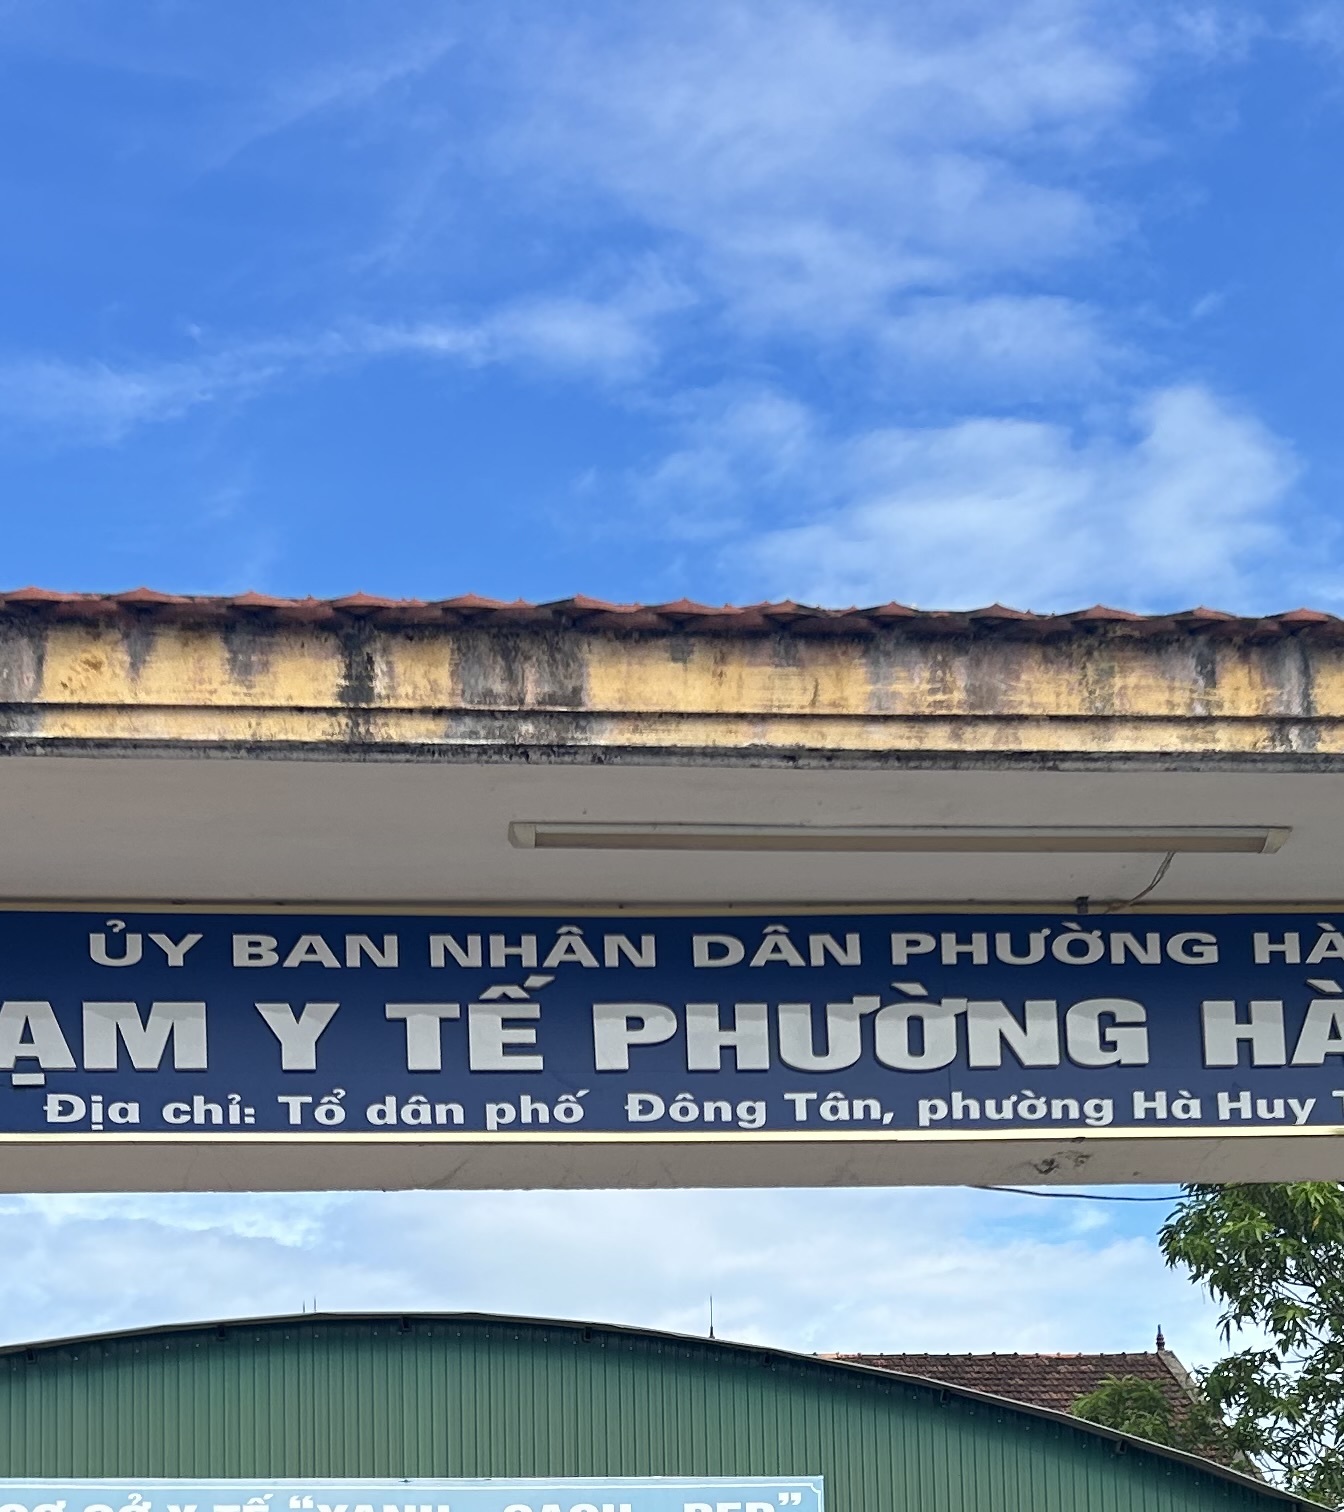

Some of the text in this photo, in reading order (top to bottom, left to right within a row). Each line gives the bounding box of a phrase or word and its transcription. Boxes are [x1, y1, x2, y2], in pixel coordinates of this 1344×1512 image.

[89, 919, 204, 967] ỦY
[233, 934, 399, 968] BAN
[429, 926, 656, 968] NHÂN
[692, 925, 862, 968] DÂN
[890, 922, 1220, 966] PHƯỜNG
[254, 1002, 340, 1071] Y
[385, 975, 554, 1071] TẾ
[592, 982, 1150, 1071] PHƯỜNG
[43, 1093, 141, 1130] Địa
[162, 1092, 256, 1126] chỉ:
[277, 1088, 347, 1126] Tổ
[366, 1094, 465, 1126] dân
[485, 1089, 589, 1131] phố
[624, 1092, 767, 1129] Đông
[783, 1091, 895, 1126] Tân,
[918, 1089, 1115, 1128] phường
[1132, 1090, 1202, 1120] Hà
[1217, 1090, 1318, 1126] Huy
